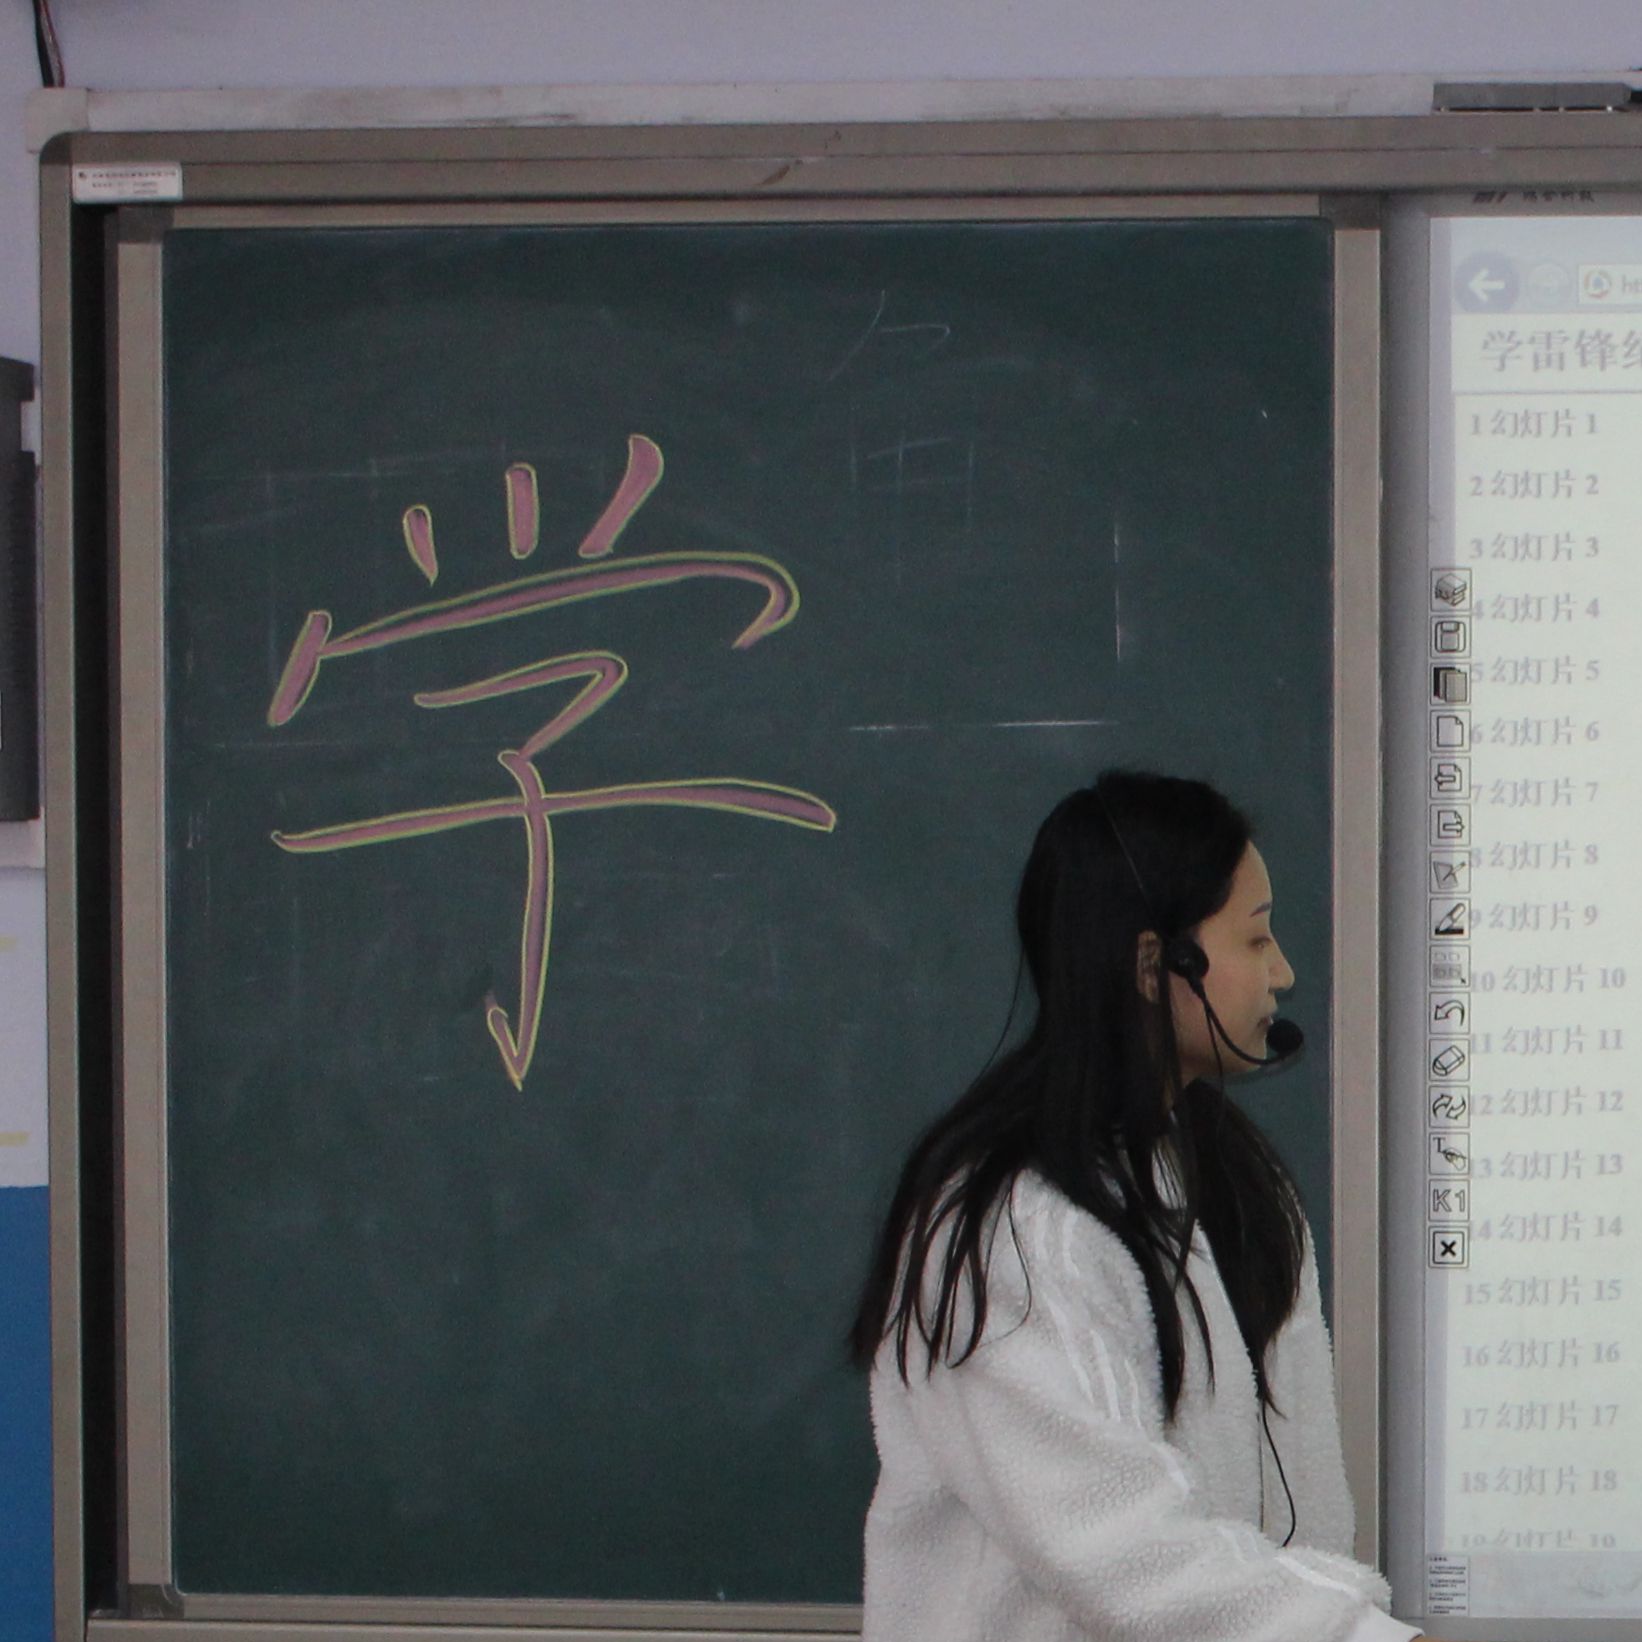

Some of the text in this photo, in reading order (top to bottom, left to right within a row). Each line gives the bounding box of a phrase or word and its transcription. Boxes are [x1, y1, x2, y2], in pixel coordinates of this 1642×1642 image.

[1470, 408, 1599, 438] 1 幻灯片 1
[1470, 468, 1599, 499] 2 幻灯片 2
[1470, 531, 1600, 562] 3 幻灯片 3
[1491, 592, 1573, 623] 幻灯片
[1585, 597, 1600, 618] 4
[1491, 655, 1573, 685] 幻灯片
[1585, 659, 1600, 681] 5
[1490, 715, 1572, 747] 幻灯片
[1585, 721, 1600, 742] 6
[266, 434, 837, 1092] 学
[1489, 776, 1572, 808] 幻灯片
[1585, 781, 1600, 802] 7
[1489, 839, 1572, 871] 幻灯片
[1584, 844, 1599, 865] 8
[1488, 900, 1571, 932] 幻灯片
[1583, 904, 1599, 926] 9
[1502, 963, 1584, 995] 幻灯片
[1600, 967, 1627, 989] 10
[1502, 1024, 1584, 1056] 幻灯片
[1599, 1028, 1623, 1051] 11
[1500, 1085, 1584, 1117] 幻灯片
[1598, 1090, 1624, 1112] 12
[1500, 1149, 1582, 1181] 幻灯片
[1597, 1153, 1623, 1176] 13
[1499, 1210, 1582, 1243] 幻灯片
[1596, 1215, 1623, 1237] 14
[1498, 1274, 1580, 1307] 幻灯片
[1595, 1278, 1622, 1302] 15
[1497, 1337, 1581, 1369] 幻灯片
[1593, 1341, 1621, 1364] 16
[1496, 1399, 1578, 1431] 幻灯片
[1593, 1403, 1620, 1427] 17
[1494, 1465, 1576, 1496] 幻灯片
